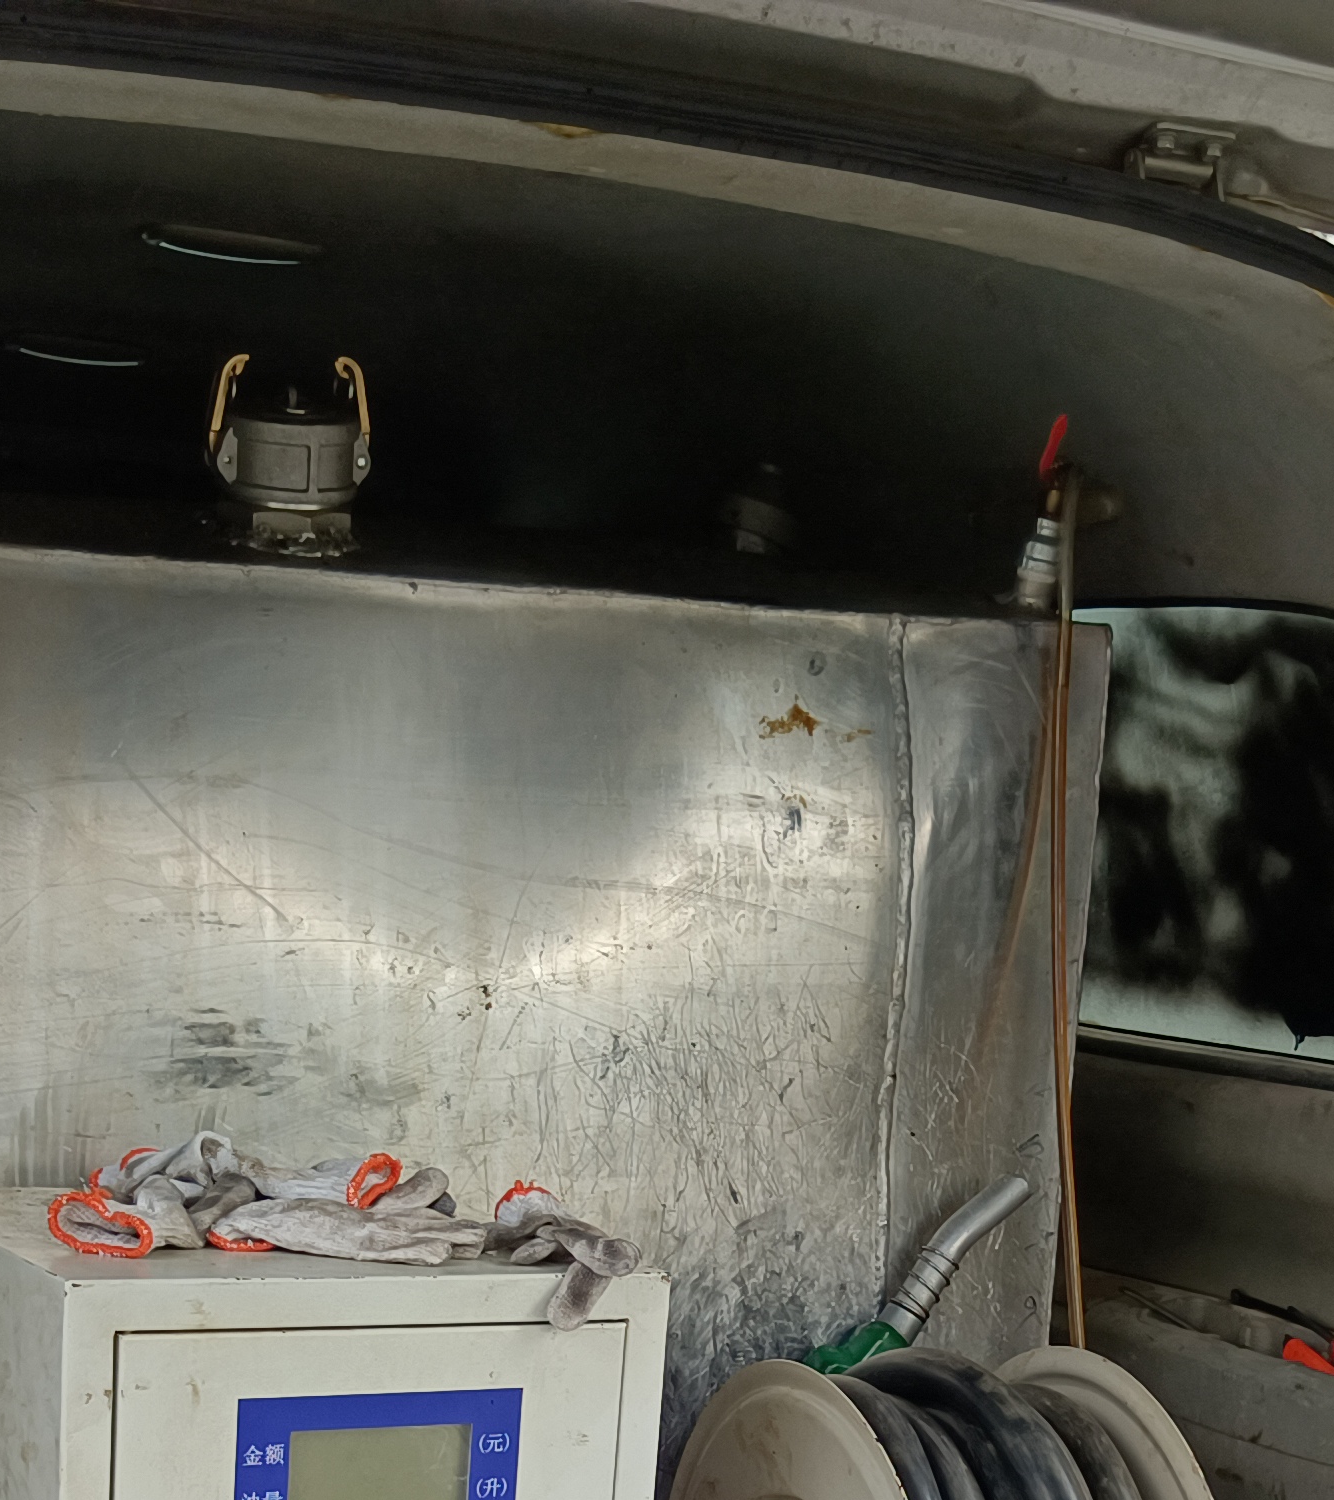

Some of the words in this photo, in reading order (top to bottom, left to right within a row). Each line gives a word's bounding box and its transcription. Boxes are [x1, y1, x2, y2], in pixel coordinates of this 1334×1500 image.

[478, 1433, 510, 1454] (元)
[242, 1443, 285, 1467] 金额
[475, 1477, 508, 1499] (升)
